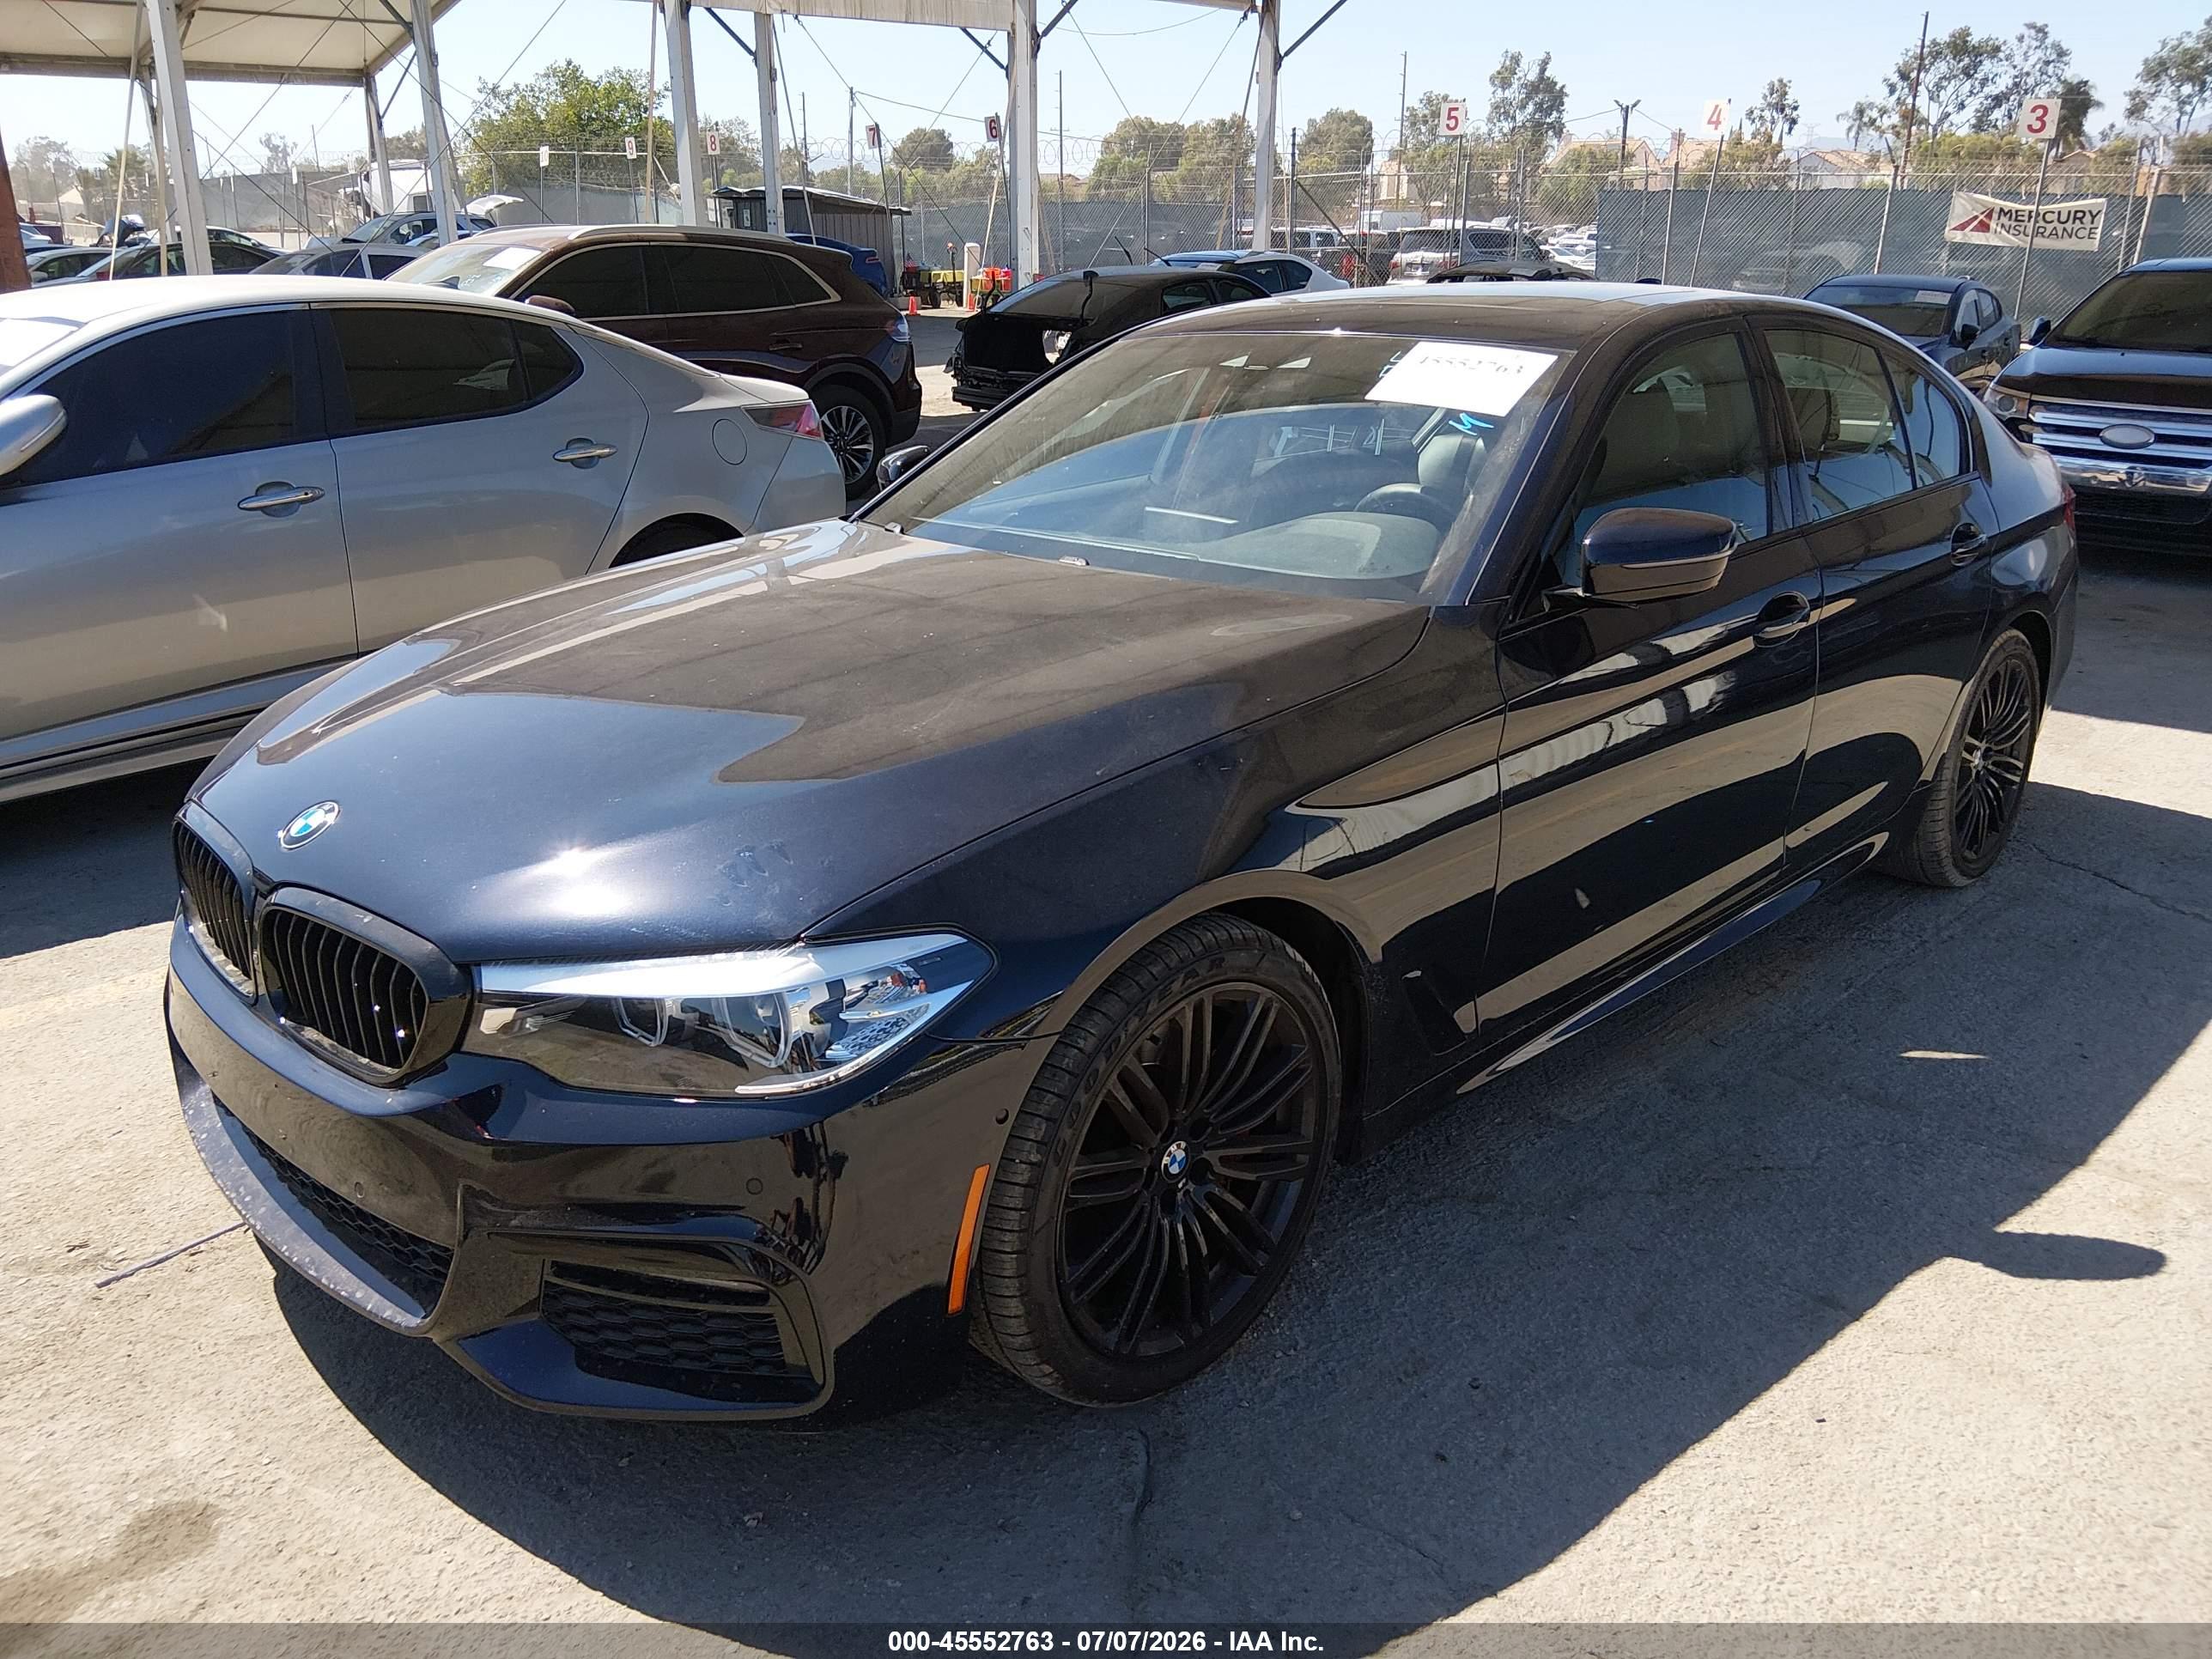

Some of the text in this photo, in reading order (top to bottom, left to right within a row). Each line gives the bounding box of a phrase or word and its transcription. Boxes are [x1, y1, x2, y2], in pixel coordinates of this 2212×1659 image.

[1445, 106, 1459, 131] 5
[1707, 104, 1722, 131] 4
[2027, 104, 2049, 134] 3
[867, 127, 877, 147] 7
[989, 119, 998, 139] 6
[628, 140, 635, 155] 9
[709, 135, 718, 152] 8
[1996, 206, 2102, 225] MERCURY
[1994, 222, 2099, 240] INSURANCE
